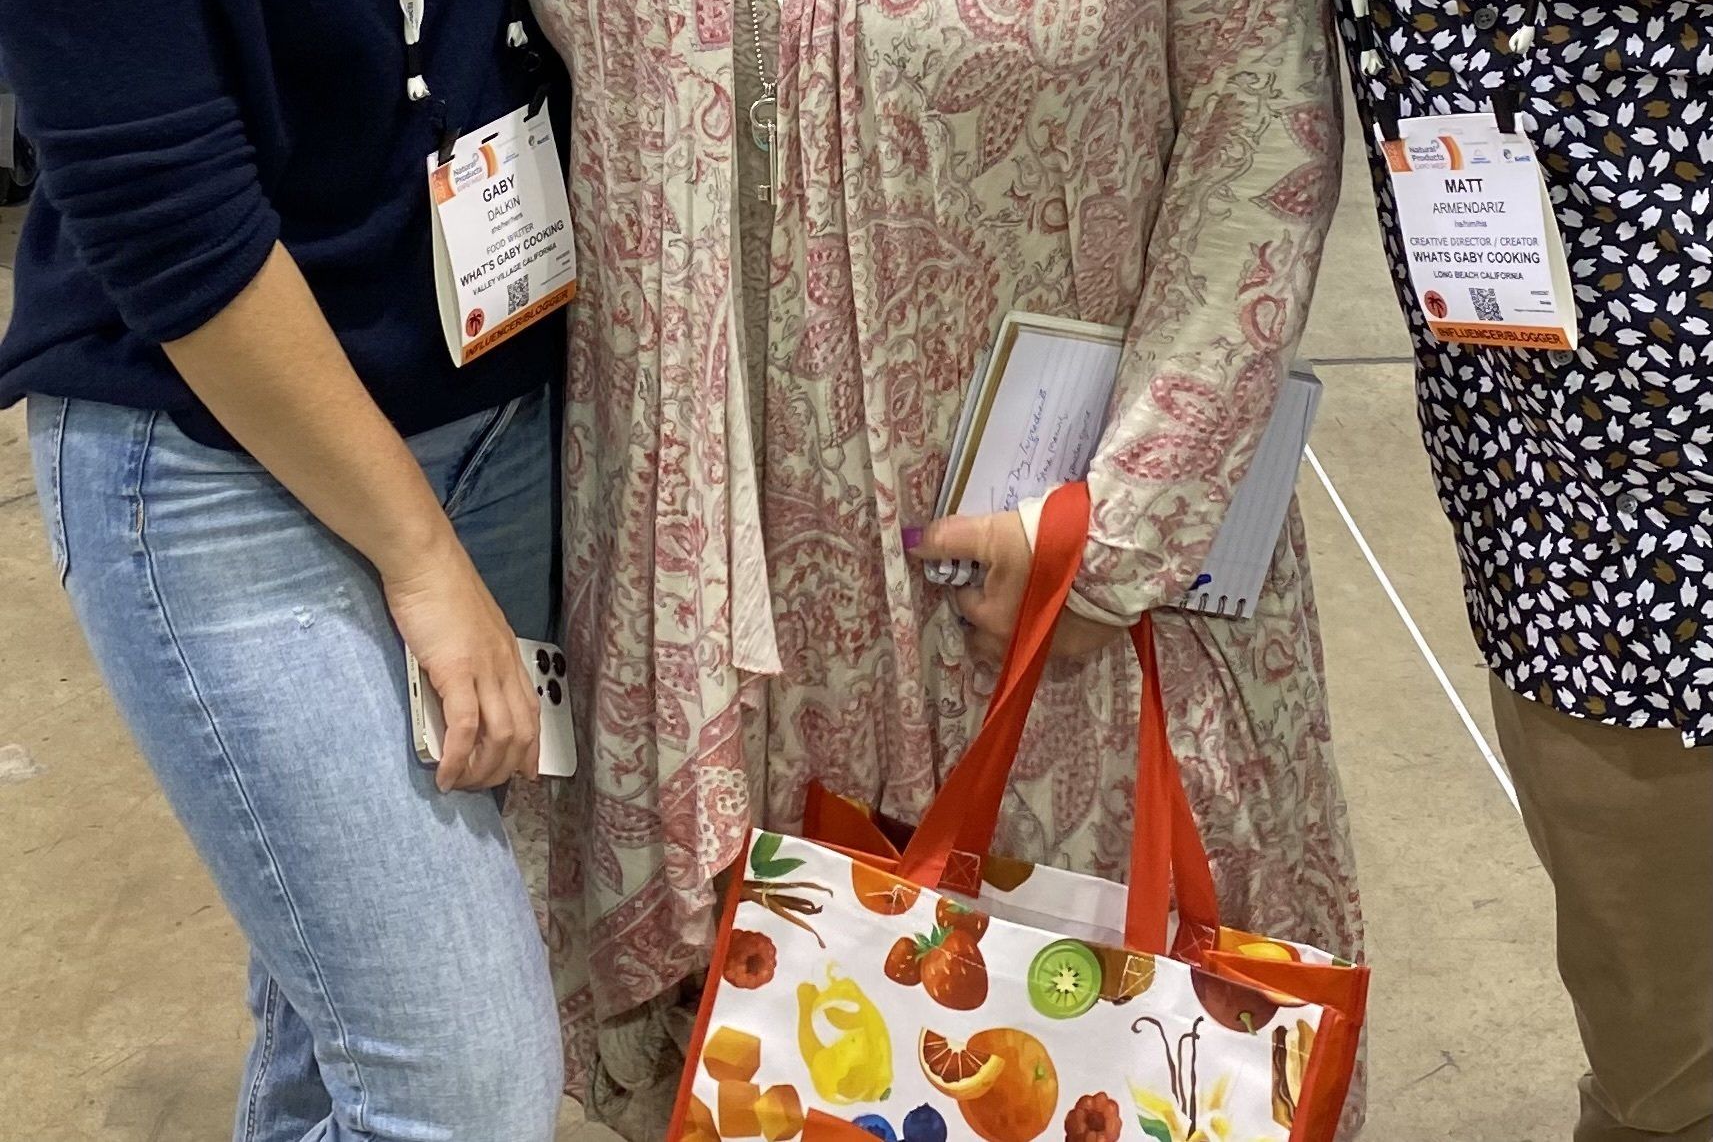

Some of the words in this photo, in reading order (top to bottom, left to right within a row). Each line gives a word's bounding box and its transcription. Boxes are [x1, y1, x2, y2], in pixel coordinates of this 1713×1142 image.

[482, 173, 515, 203] GABY
[1445, 178, 1483, 194] MATT
[487, 194, 521, 222] DALKIN
[1433, 201, 1507, 214] ARMENDARIZ
[486, 238, 507, 255] FOOD
[507, 222, 535, 243] WRITER
[1410, 237, 1449, 247] CREATIVE
[1450, 237, 1492, 247] DIRECTOR
[1499, 237, 1539, 247] CREATOR
[460, 260, 496, 287] WHAT'S
[496, 242, 521, 266] GABY
[523, 219, 565, 251] COOKING
[1413, 251, 1452, 263] WHATS
[1453, 251, 1484, 264] GABY
[1486, 251, 1541, 264] COOKING
[473, 277, 496, 296] VALLEY
[522, 242, 557, 268] CALIFORNIA
[1433, 270, 1454, 279] LONG
[1454, 270, 1479, 279] BEACH
[1479, 271, 1524, 280] CALIFORNIA
